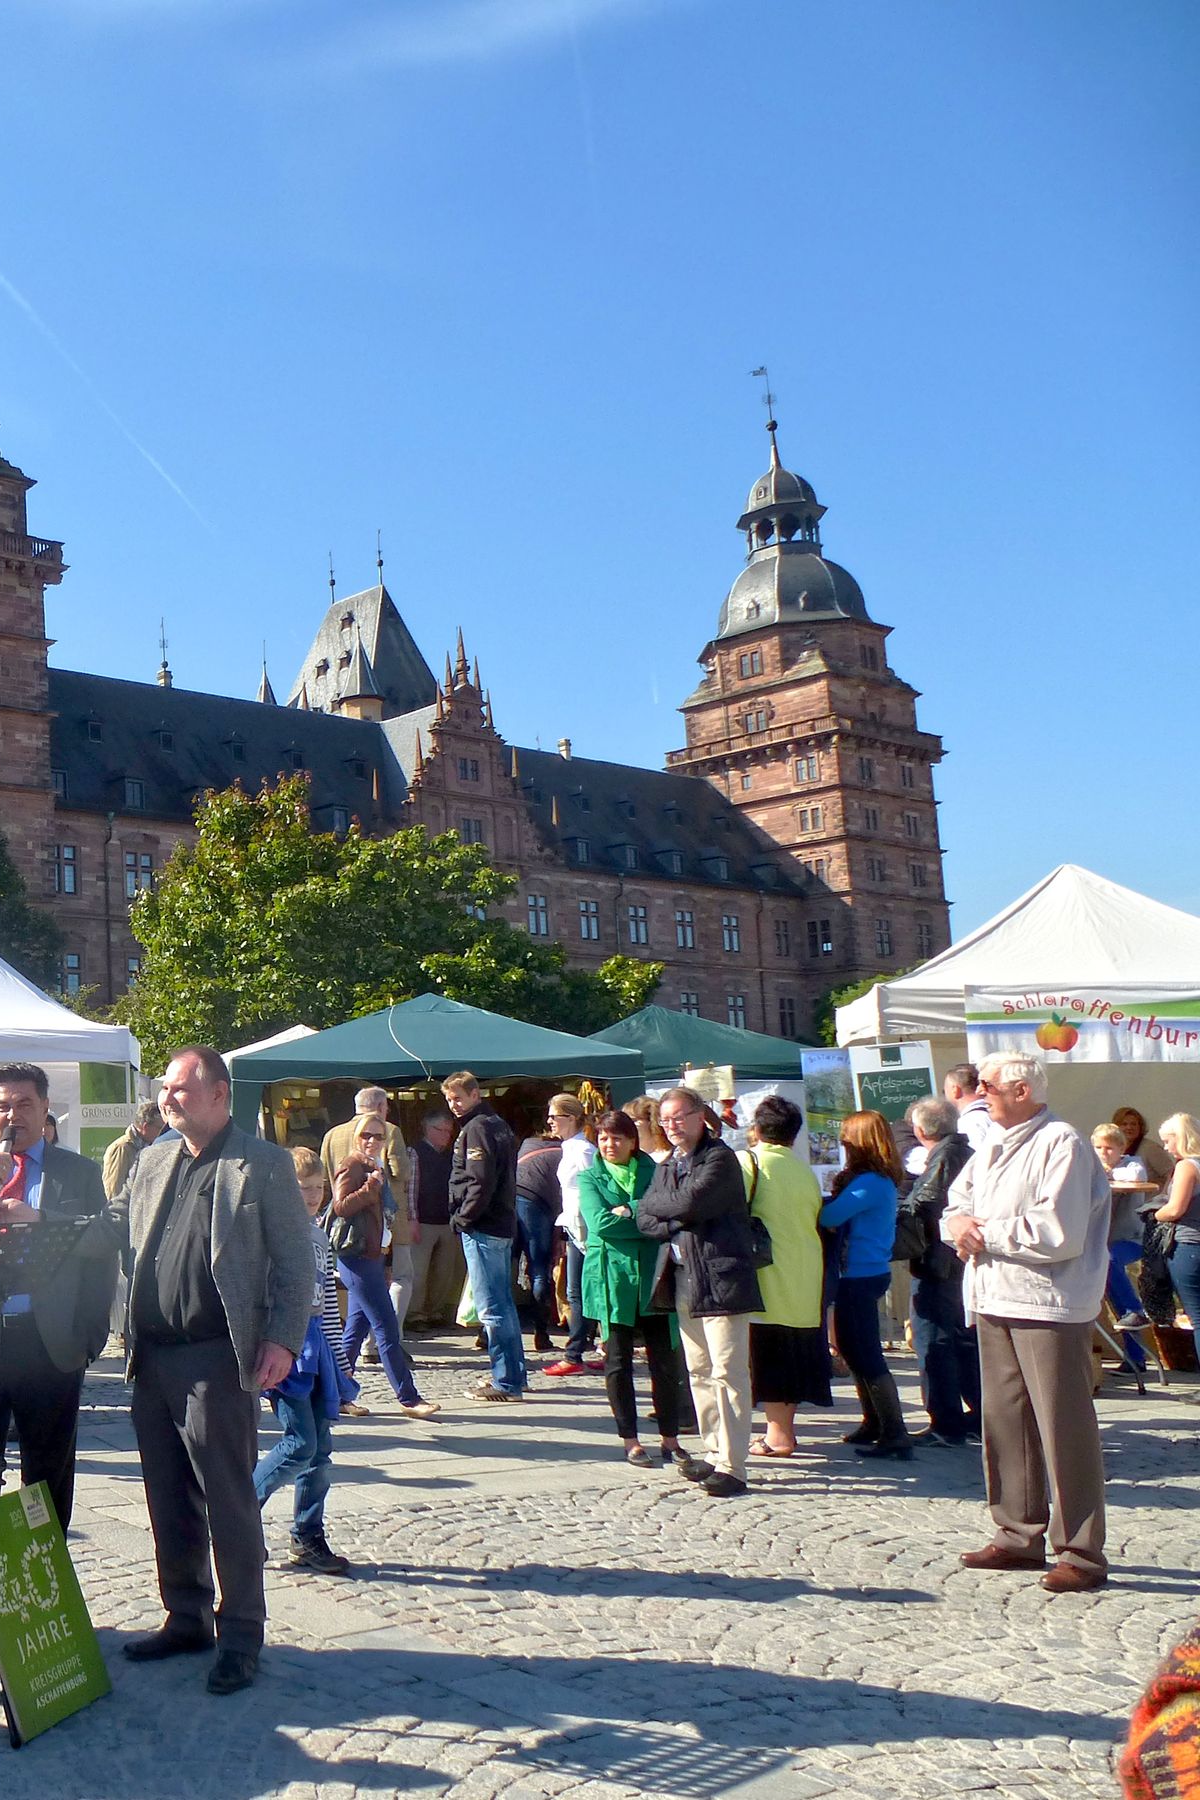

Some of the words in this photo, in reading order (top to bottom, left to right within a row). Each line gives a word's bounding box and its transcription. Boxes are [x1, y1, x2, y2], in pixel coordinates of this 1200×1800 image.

[1003, 991, 1198, 1048] Schlaraffenbur
[81, 1106, 111, 1118] GRÜNES
[826, 1119, 843, 1128] Str
[0, 1535, 60, 1624] 40
[17, 1613, 72, 1664] JAHRE
[29, 1654, 82, 1692] KREISGRUPPE
[36, 1671, 87, 1709] ASCHAFFENBURG
